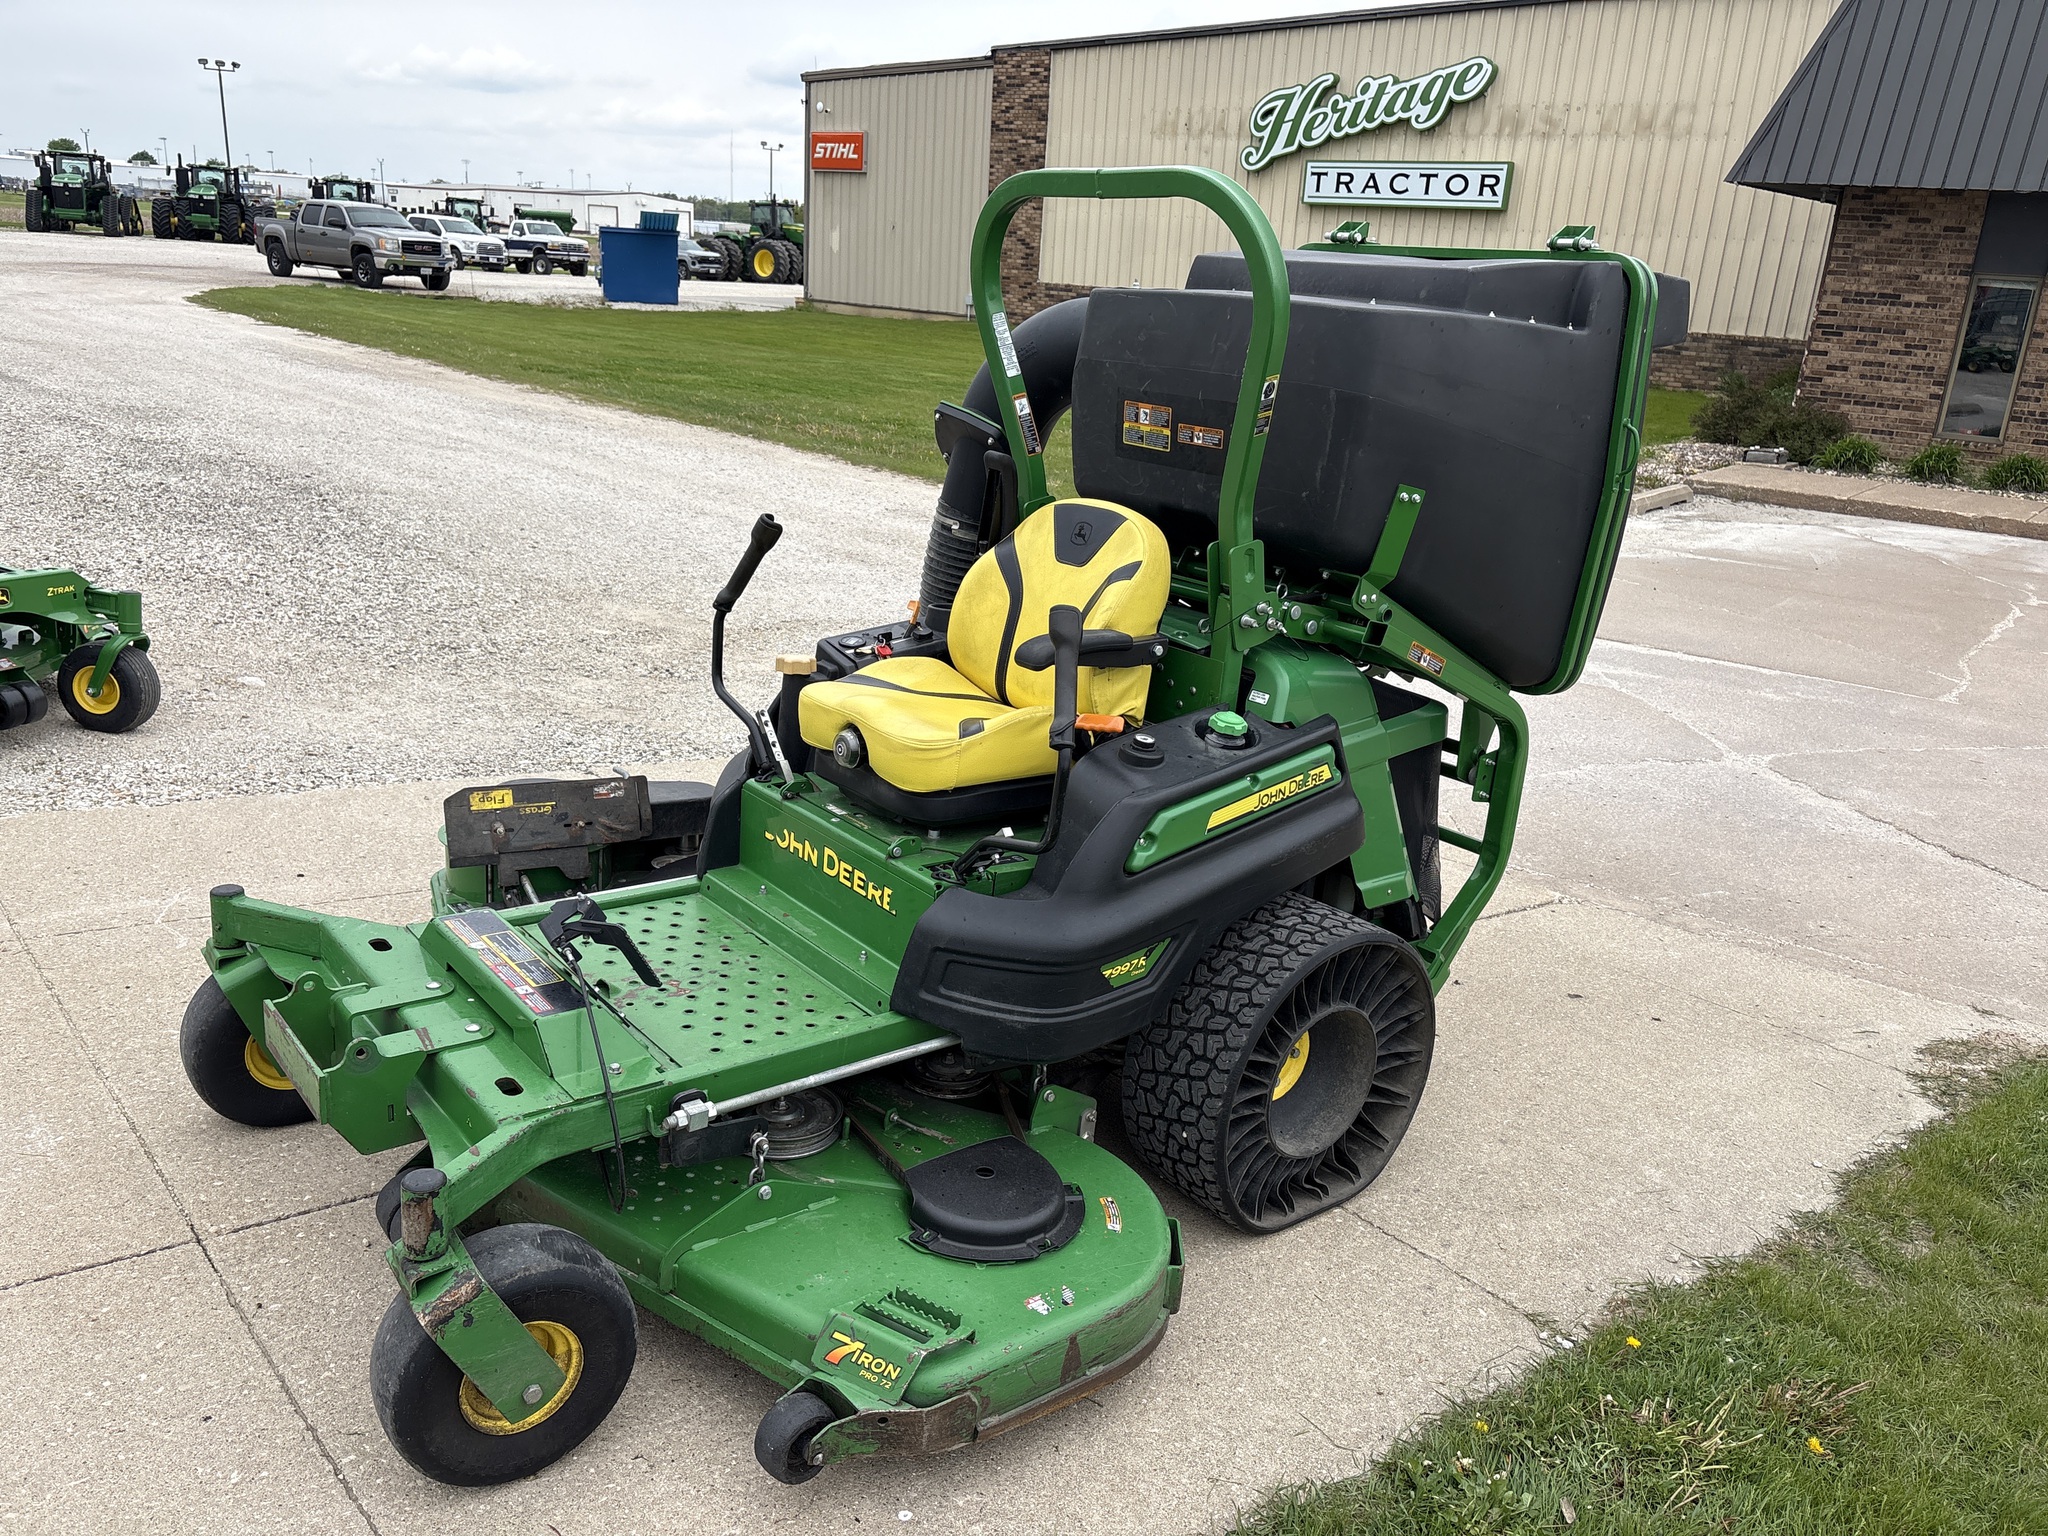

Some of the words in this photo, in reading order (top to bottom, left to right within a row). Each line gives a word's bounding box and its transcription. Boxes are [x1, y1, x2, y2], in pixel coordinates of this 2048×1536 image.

[1241, 57, 1495, 169] Heritage
[813, 142, 859, 160] STIHL
[1310, 169, 1502, 198] TRACTOR
[46, 584, 76, 597] ZTRAK
[478, 794, 505, 805] Flap
[1253, 787, 1287, 810] JOHN
[519, 805, 553, 815] Grass
[764, 828, 819, 868] OHN
[858, 1368, 879, 1383] PRO
[879, 1377, 893, 1390] 72
